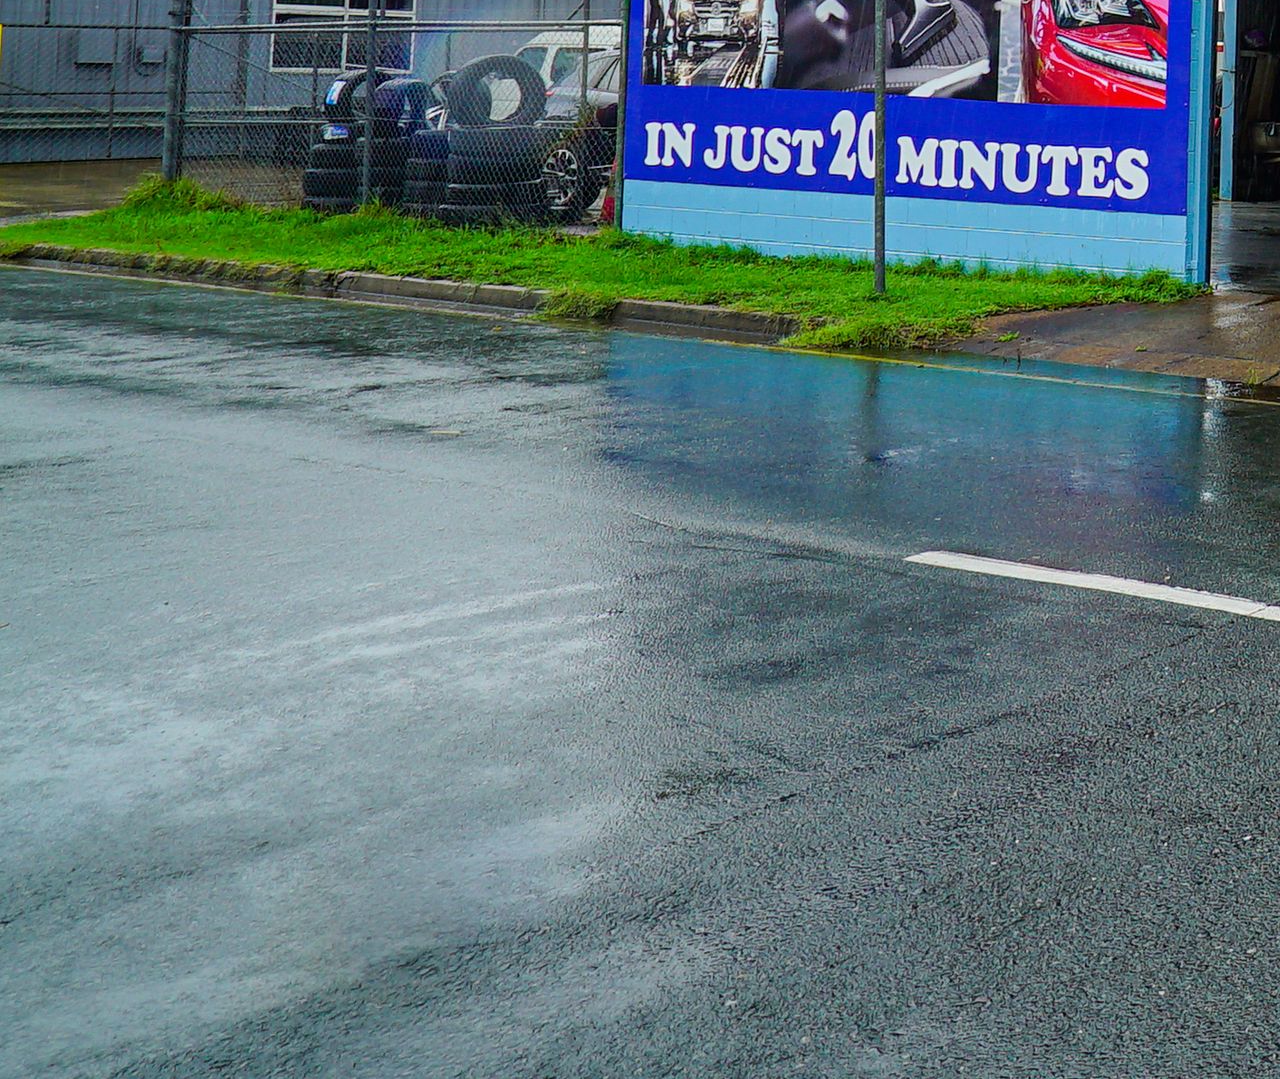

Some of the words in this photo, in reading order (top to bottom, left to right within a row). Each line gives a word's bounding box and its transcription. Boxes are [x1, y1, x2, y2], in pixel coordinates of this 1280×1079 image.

[645, 123, 695, 167] IN
[704, 126, 823, 175] JUST
[896, 137, 1148, 199] MINUTES
